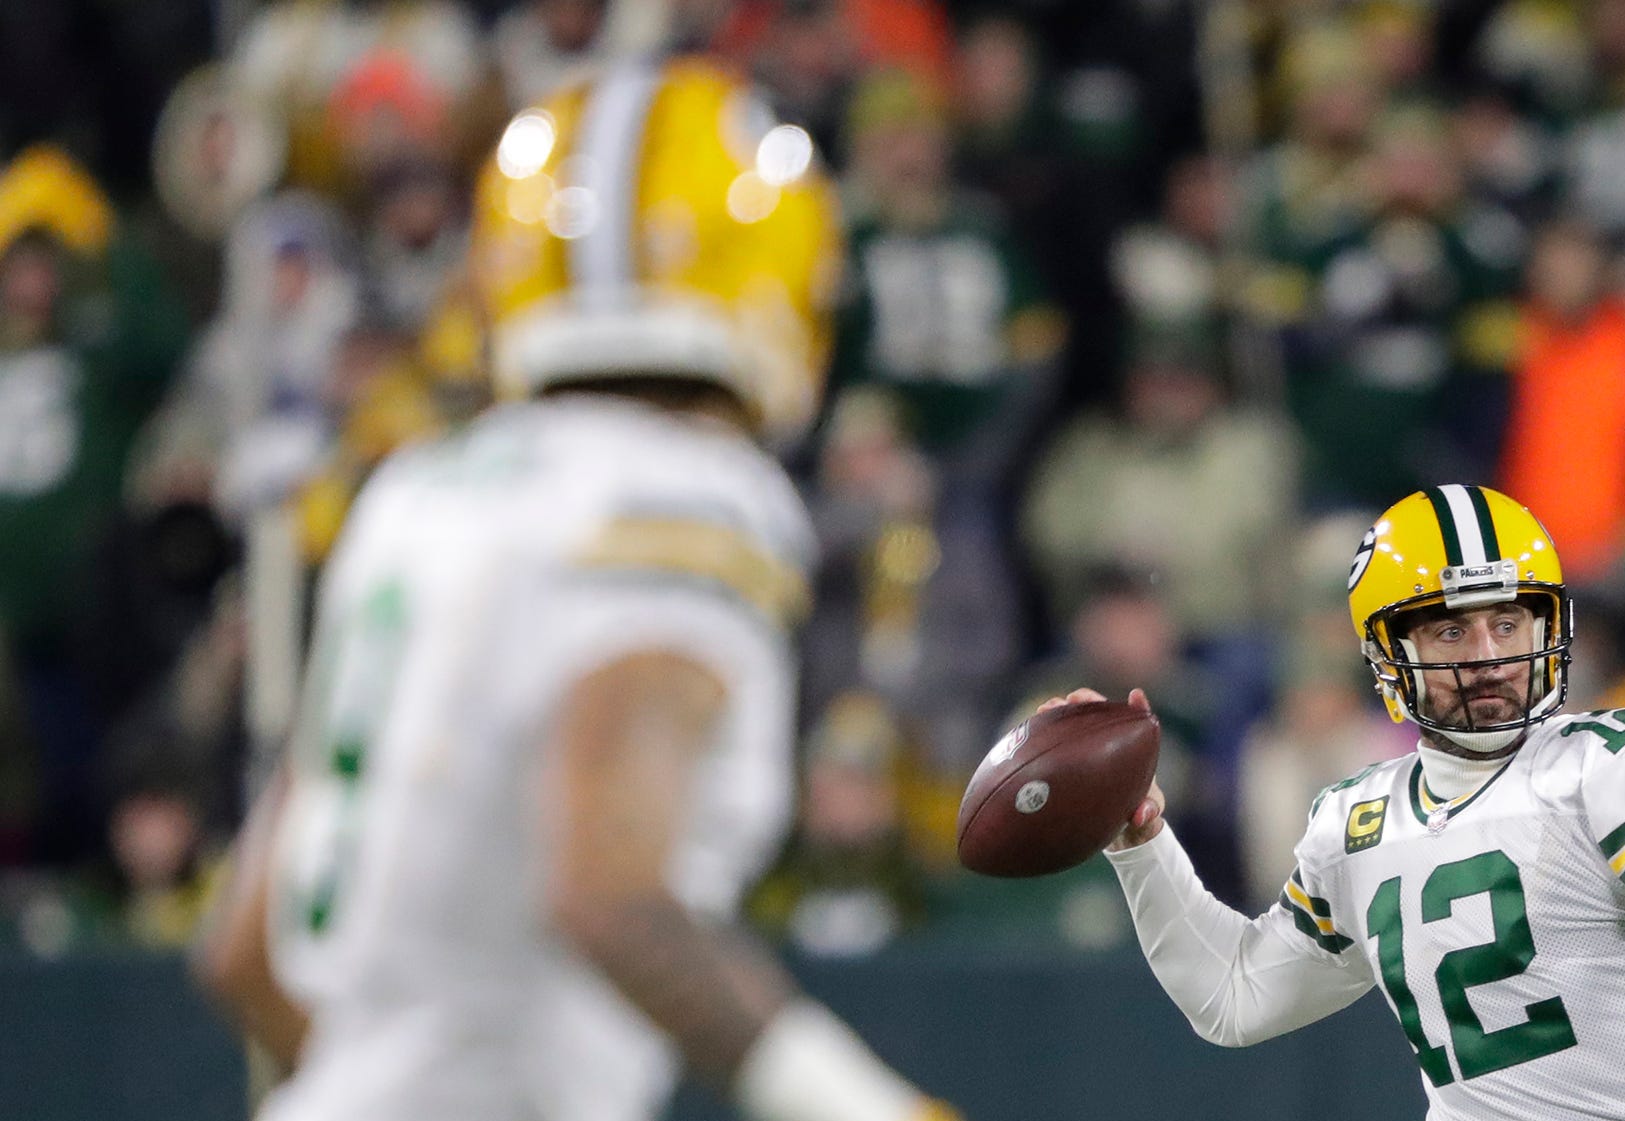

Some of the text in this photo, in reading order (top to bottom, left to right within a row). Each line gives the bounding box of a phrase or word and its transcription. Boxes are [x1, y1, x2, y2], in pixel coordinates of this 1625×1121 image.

[1460, 566, 1494, 578] PACS
[1348, 799, 1385, 838] C
[1366, 849, 1578, 1088] 12
